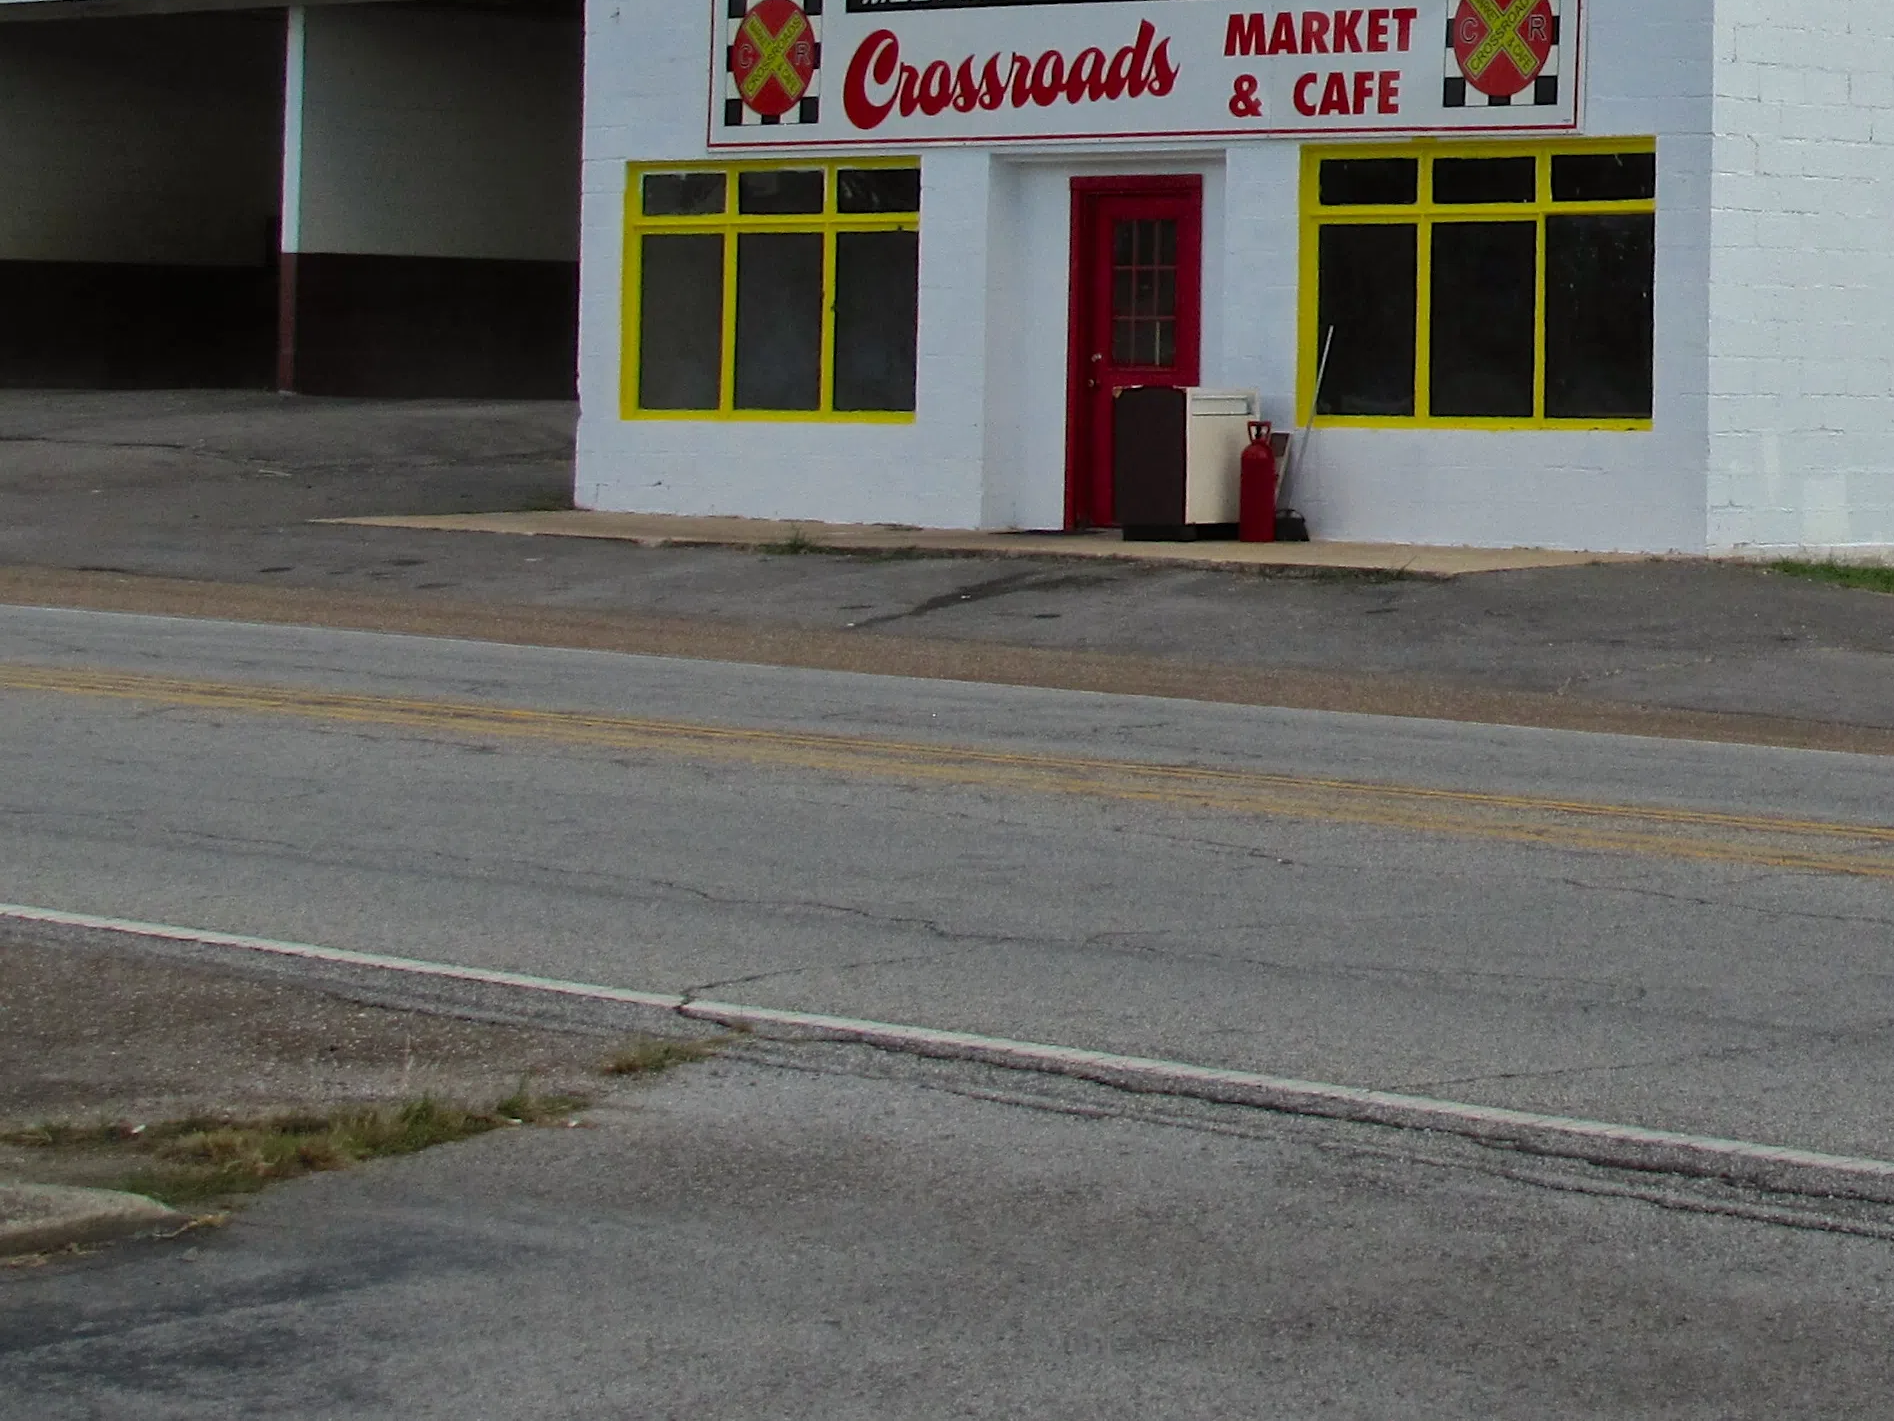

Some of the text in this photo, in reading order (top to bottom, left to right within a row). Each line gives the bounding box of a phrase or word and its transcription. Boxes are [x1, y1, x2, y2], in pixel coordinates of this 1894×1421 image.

[1224, 8, 1417, 56] MARKET
[1462, 14, 1547, 43] C R
[739, 41, 810, 68] C R
[843, 19, 1181, 130] Crossroads
[1229, 71, 1401, 118] & CAFE
